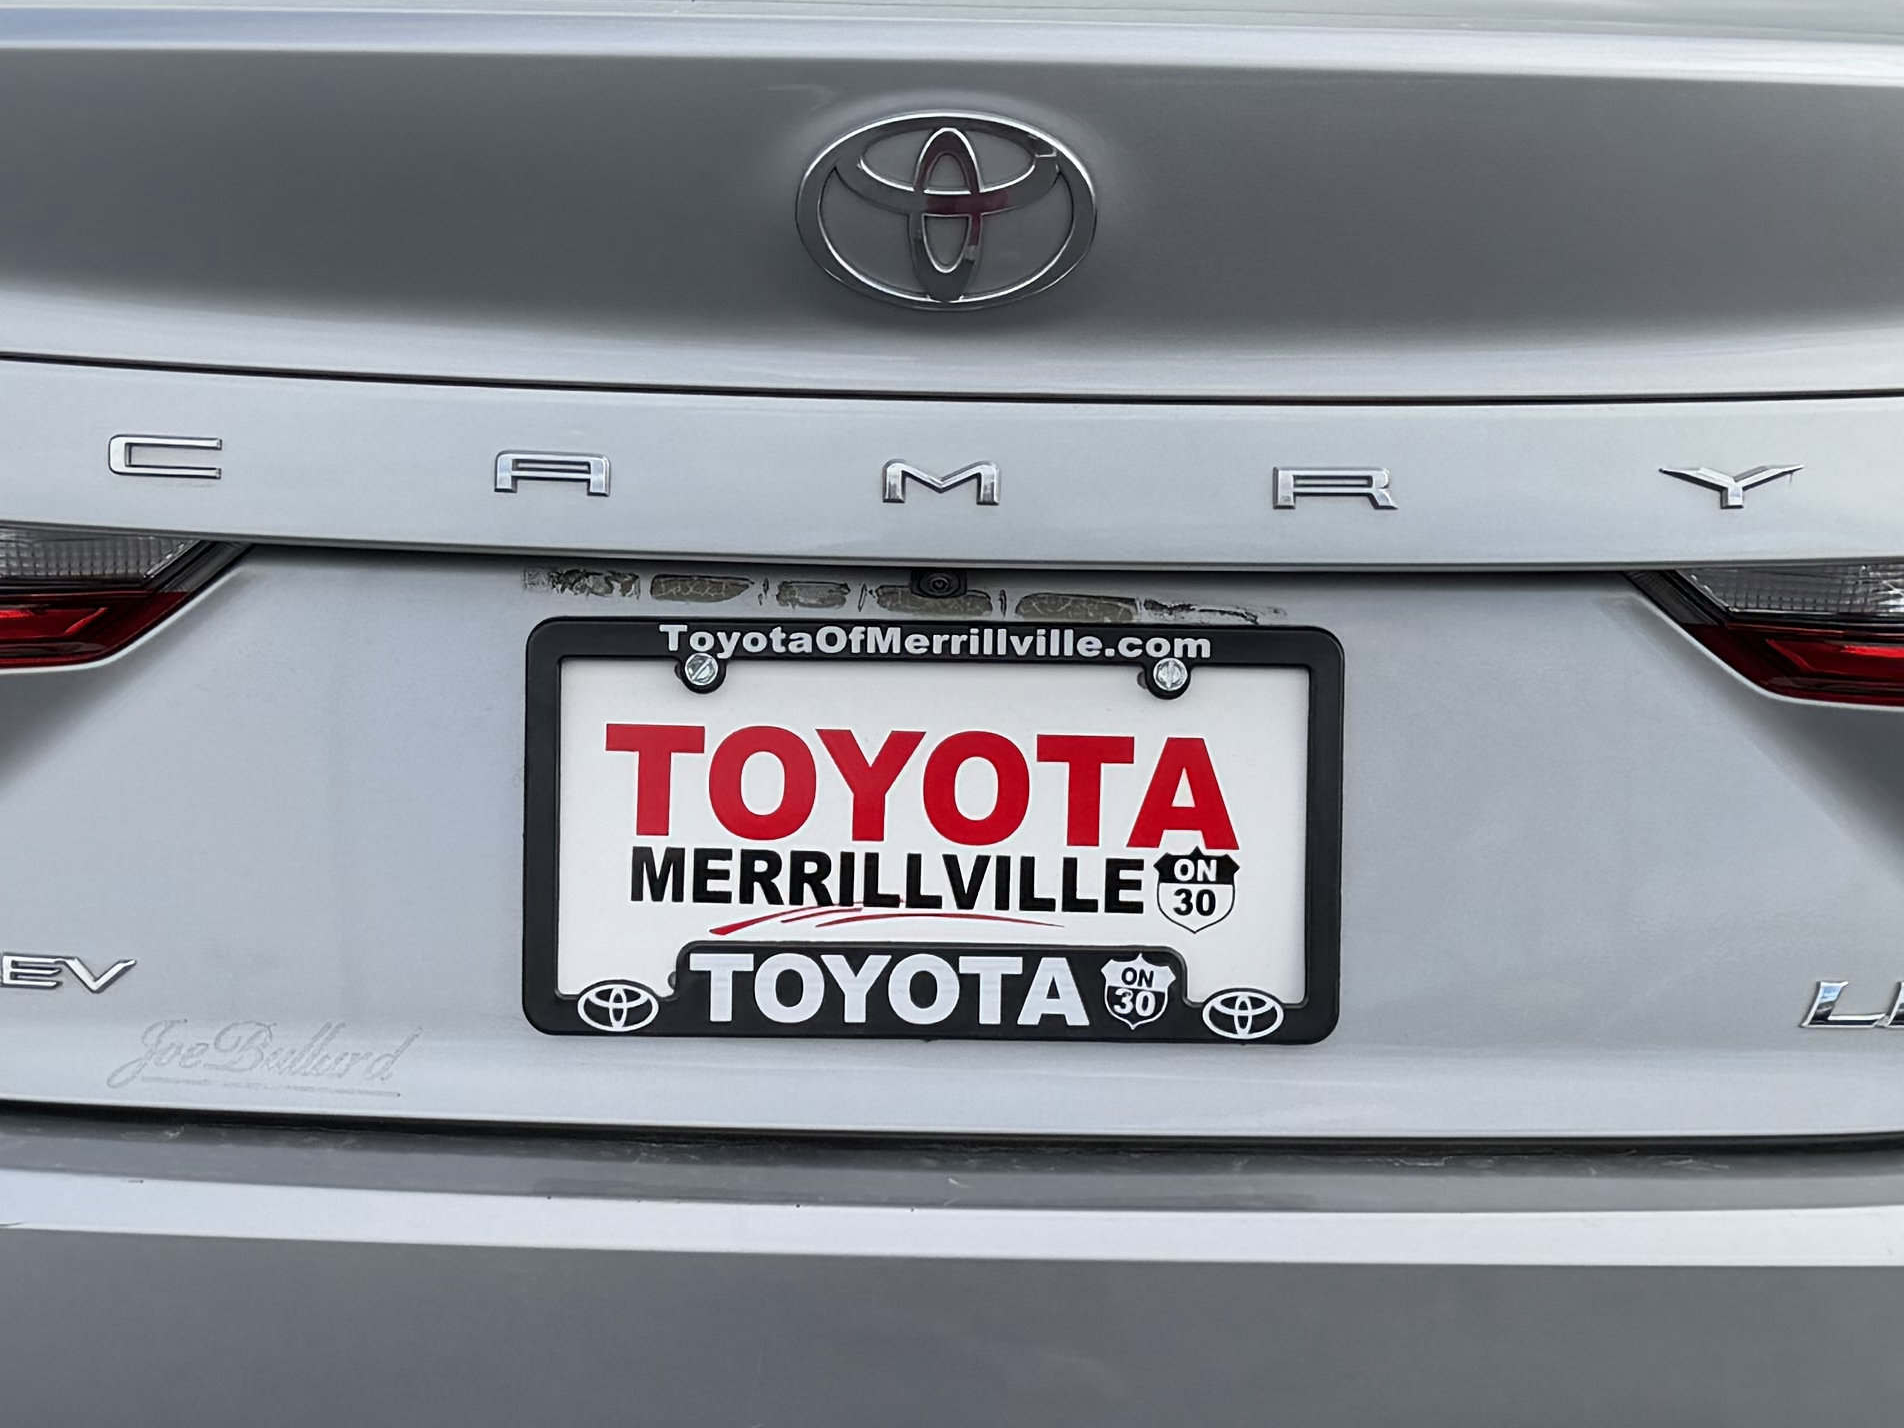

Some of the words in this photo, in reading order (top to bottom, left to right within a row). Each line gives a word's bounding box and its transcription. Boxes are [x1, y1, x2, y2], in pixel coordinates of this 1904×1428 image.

[107, 434, 1805, 510] CAMRY
[659, 623, 1212, 659] ToyotaOfMerrillville.com
[605, 723, 1239, 851] TOYOTA
[631, 847, 1143, 914] MERRILLVILLE
[1174, 857, 1217, 884] ON
[1172, 888, 1217, 918] 30
[690, 953, 1089, 1027] TOYOTA
[1120, 966, 1156, 989] ON
[1113, 989, 1156, 1018] 30
